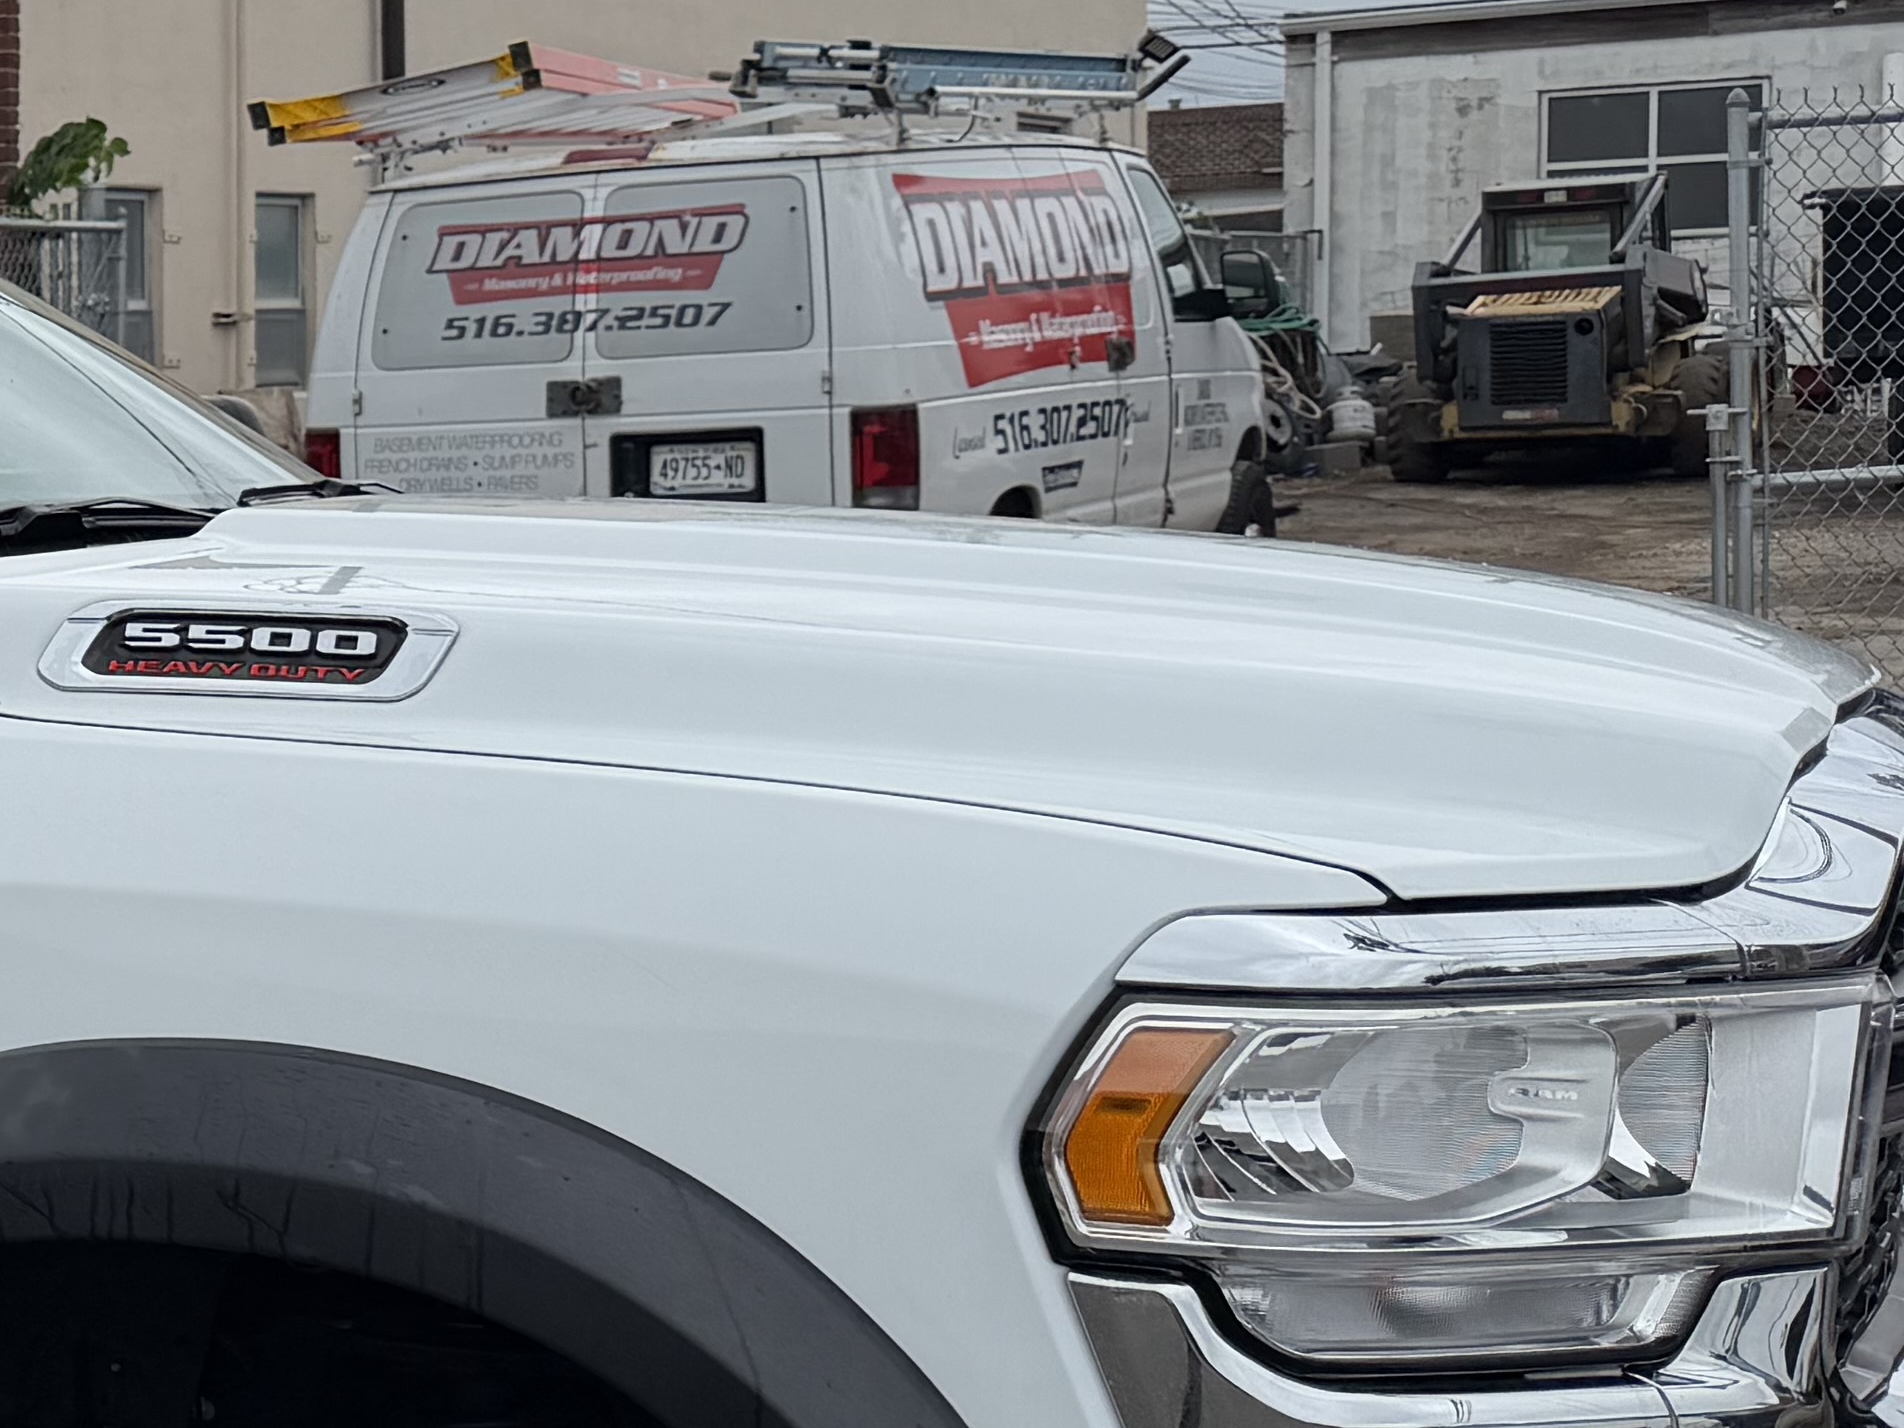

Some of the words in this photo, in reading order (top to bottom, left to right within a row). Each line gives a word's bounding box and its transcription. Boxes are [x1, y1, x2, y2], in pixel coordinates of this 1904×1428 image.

[426, 212, 749, 273] DIAMOND
[907, 190, 1131, 296] DIAMOND
[373, 434, 445, 454] BASEMENT
[993, 398, 1128, 454] 516.307.2507
[120, 622, 378, 656] 5500
[108, 659, 244, 678] HEAVY
[249, 663, 366, 682] DUTY
